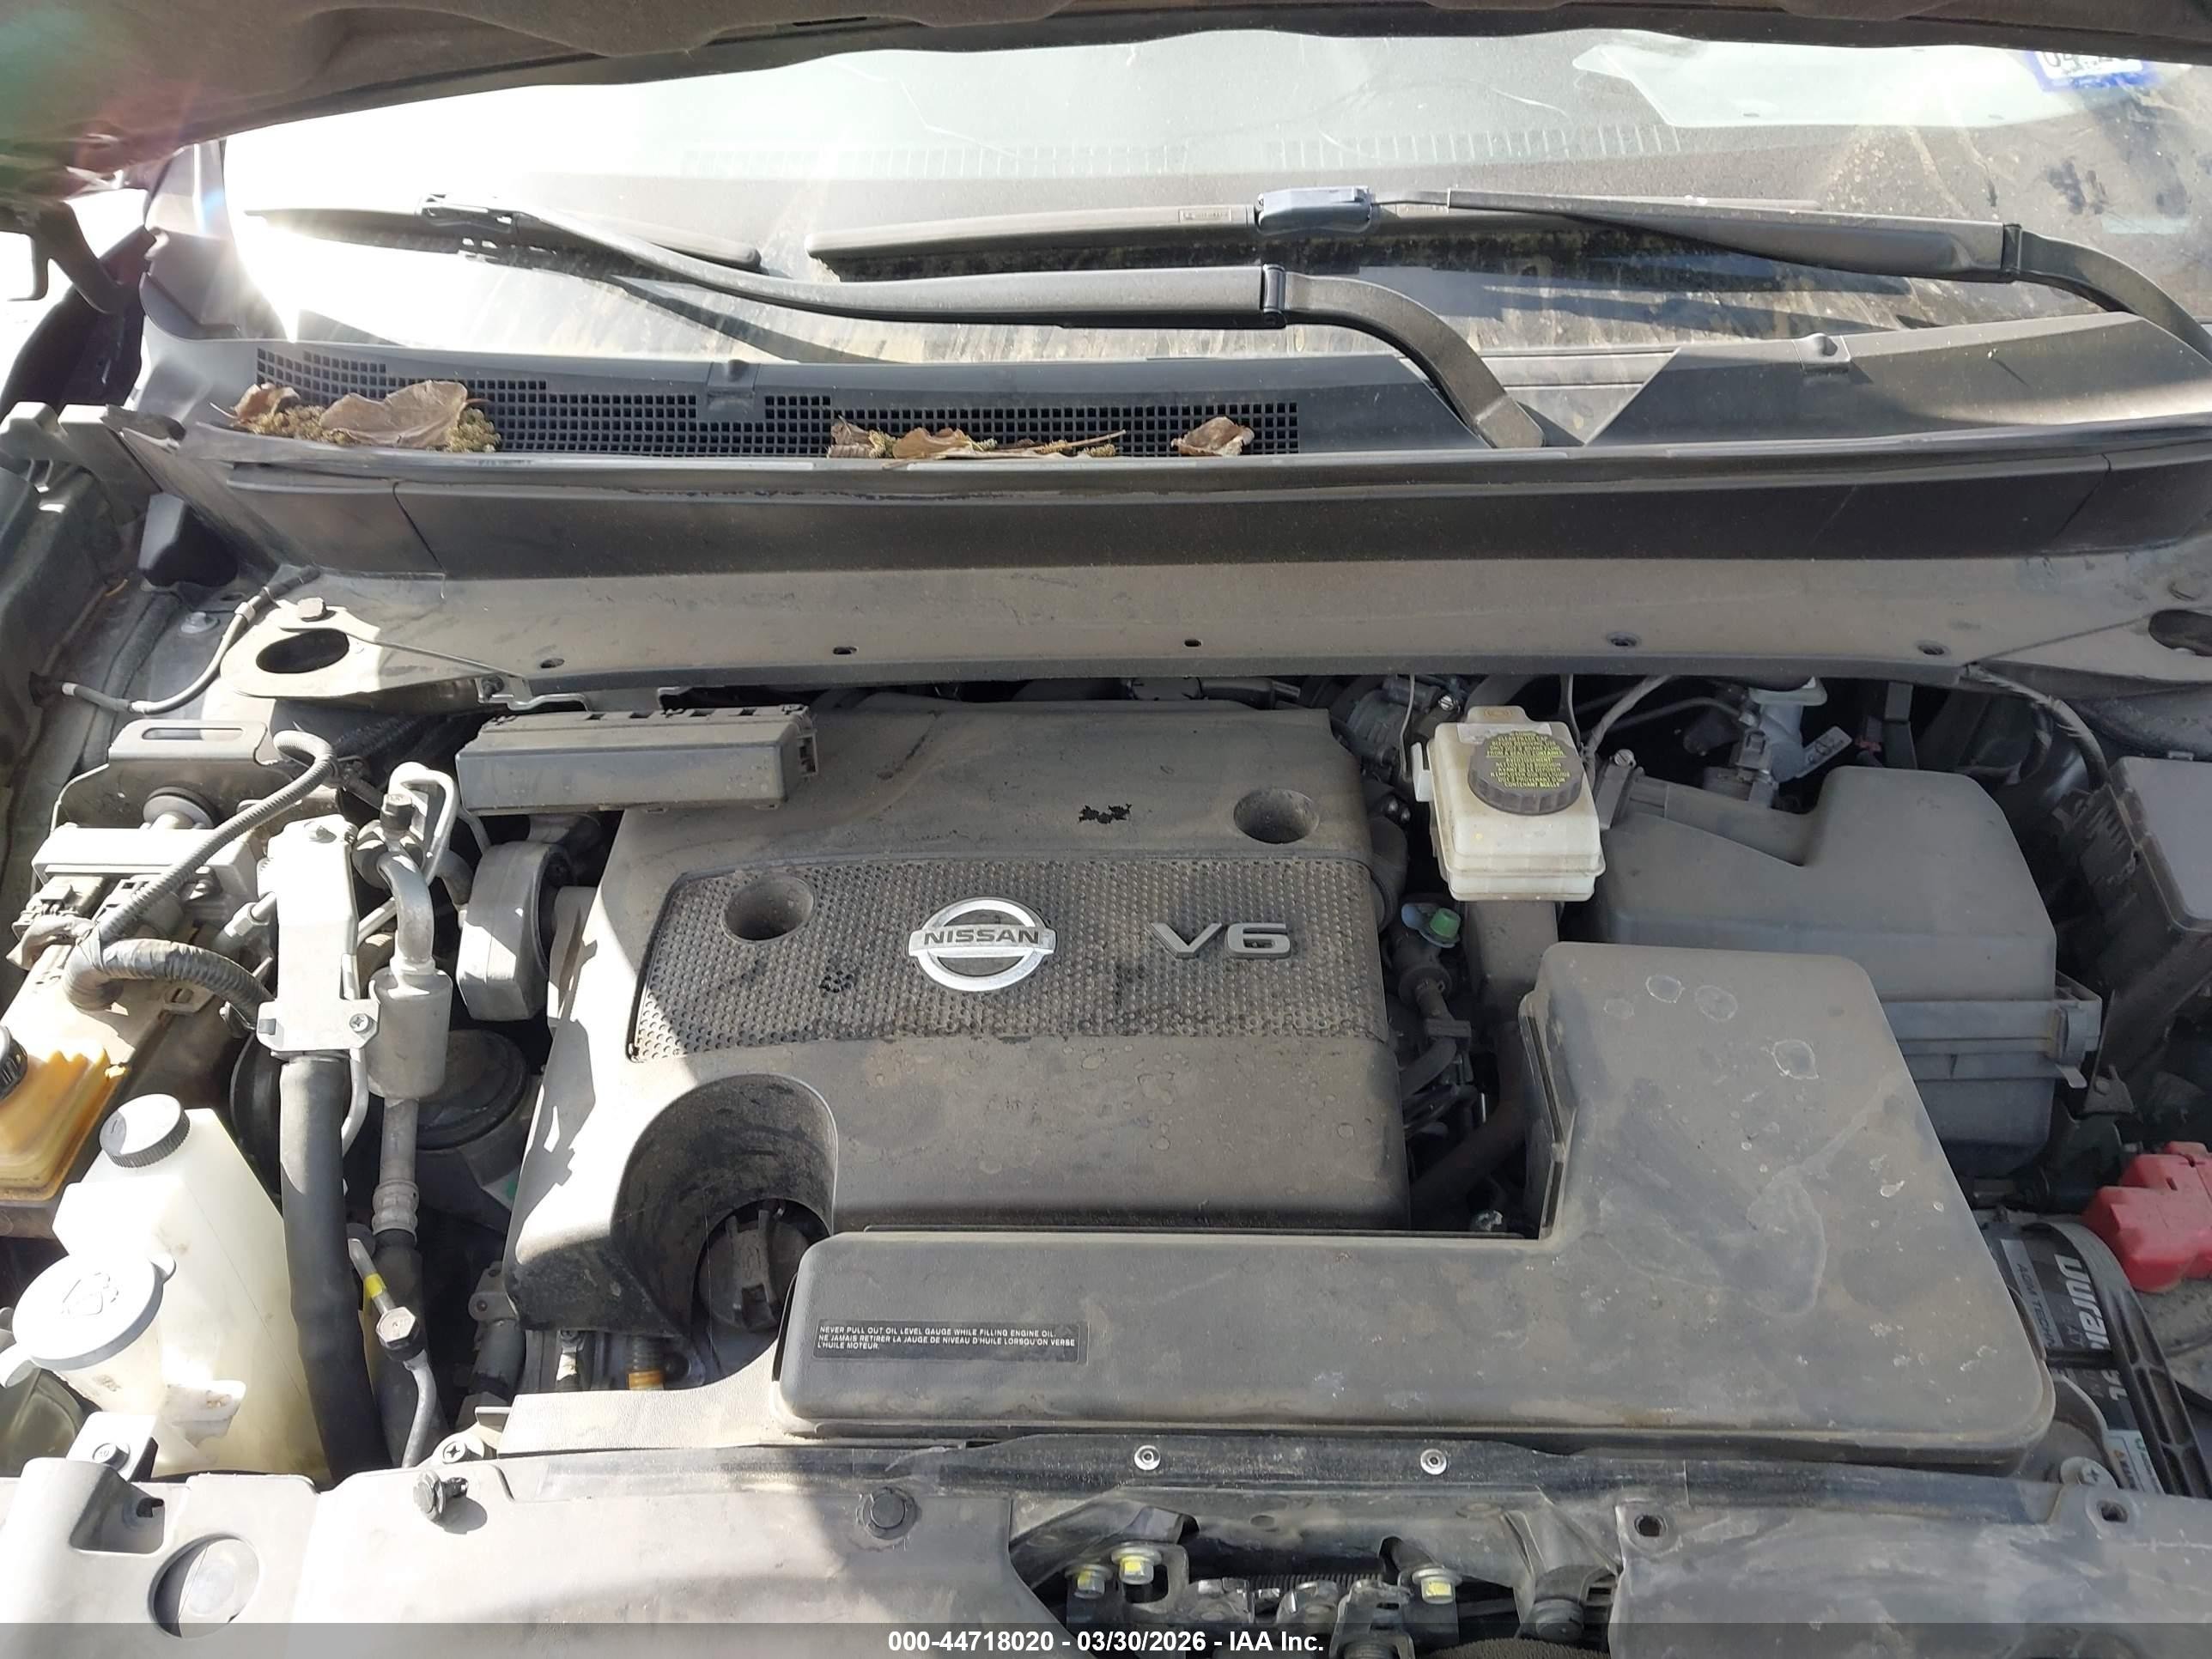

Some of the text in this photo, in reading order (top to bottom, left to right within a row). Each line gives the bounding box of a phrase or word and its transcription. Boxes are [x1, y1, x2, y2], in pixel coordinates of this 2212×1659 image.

[924, 930, 1039, 945] NISSAN
[1151, 922, 1291, 960] V6
[847, 1326, 866, 1334] PULL
[867, 1326, 883, 1334] OUT
[885, 1327, 898, 1335] OIL
[954, 1328, 977, 1336] WHILE
[980, 1328, 1008, 1337] FILLING
[860, 1334, 890, 1343] RETIRER
